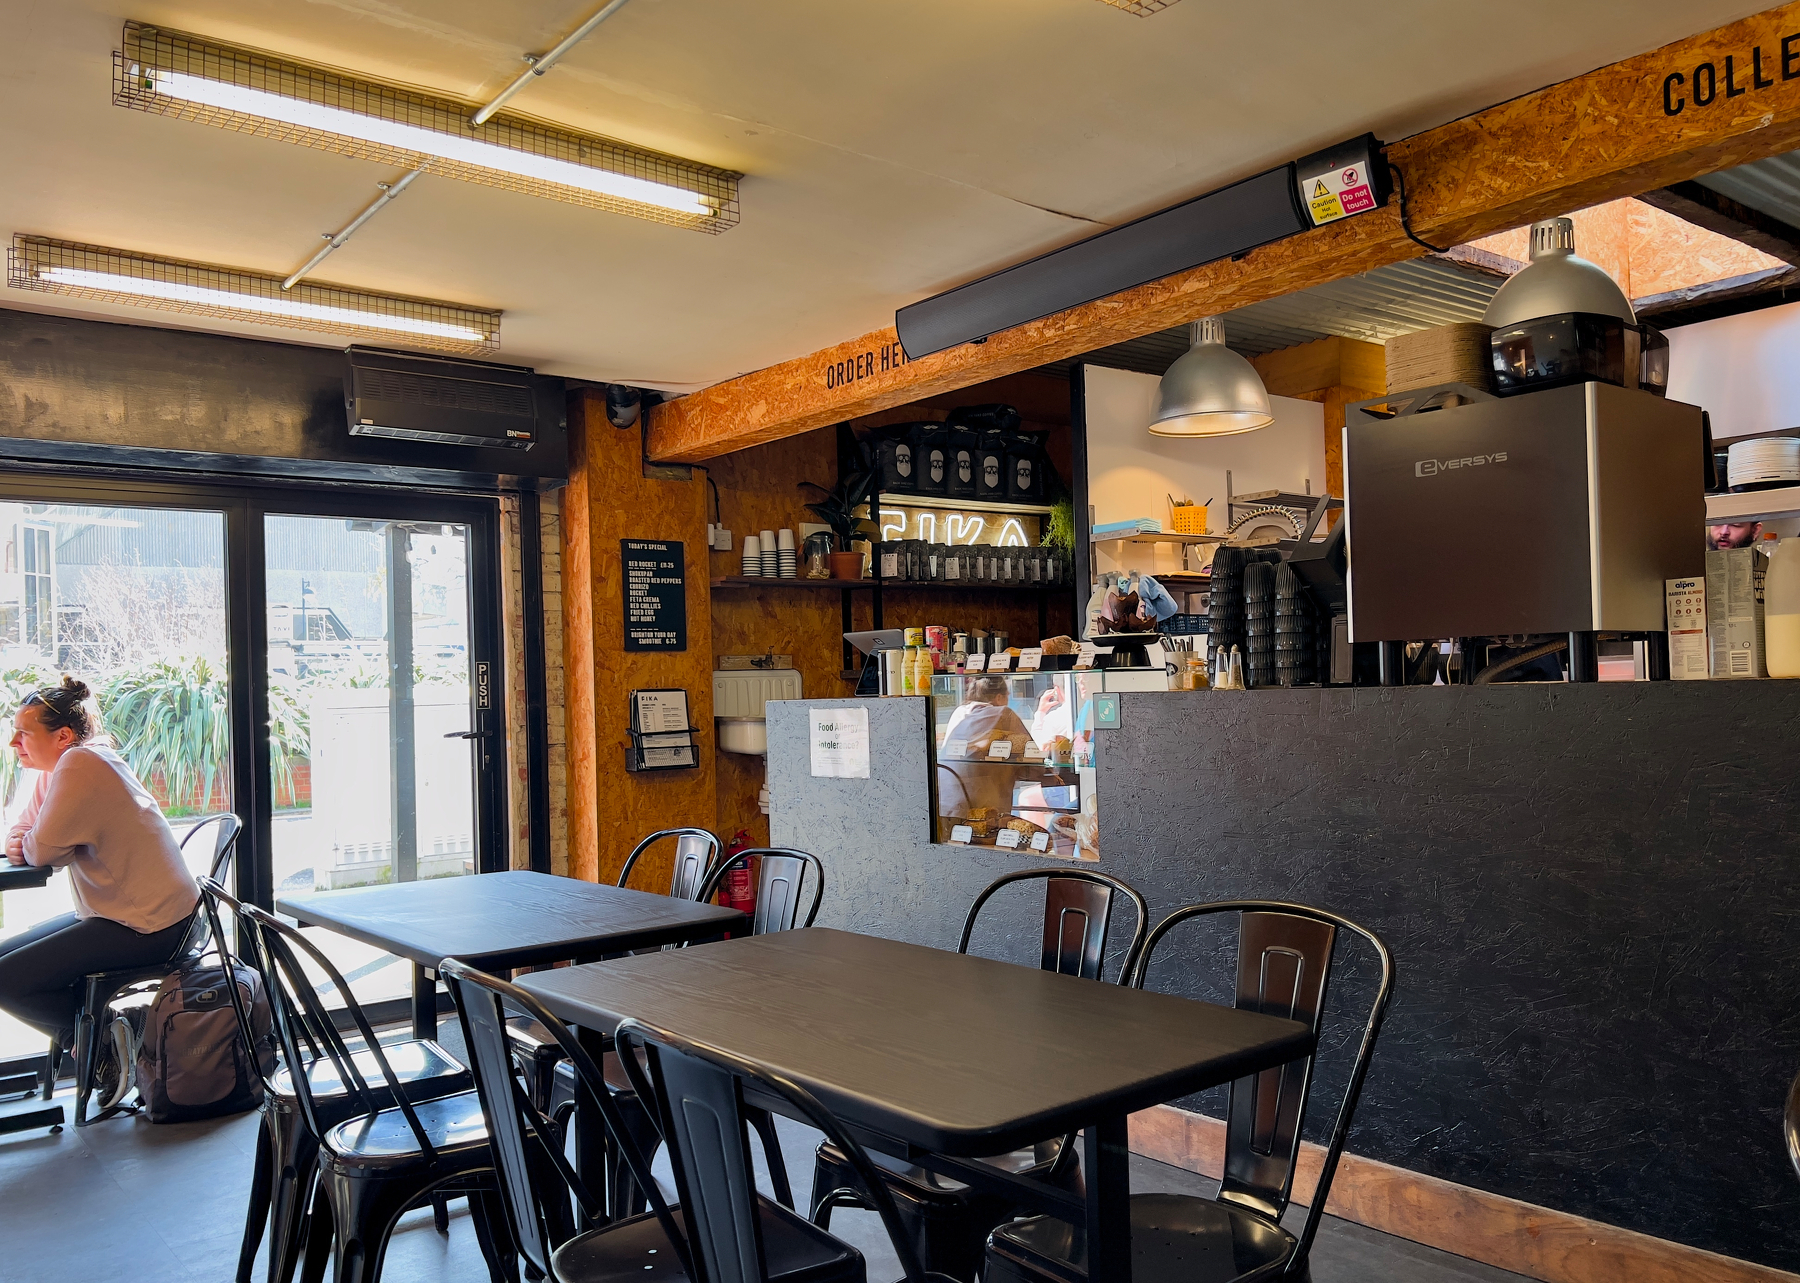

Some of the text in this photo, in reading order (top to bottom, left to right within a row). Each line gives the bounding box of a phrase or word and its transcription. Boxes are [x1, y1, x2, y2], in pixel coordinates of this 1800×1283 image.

[1663, 33, 1800, 117] COLLE
[1342, 189, 1368, 202] Do not
[1311, 197, 1337, 209] Caution
[1346, 199, 1369, 210] touch
[1319, 211, 1338, 220] surface
[827, 351, 874, 390] ORDER
[628, 542, 648, 550] TODAY'S
[660, 577, 682, 585] PEPPERS
[1674, 581, 1696, 590] alpro
[478, 664, 488, 706] PUSH
[818, 722, 859, 734] Food Allergy
